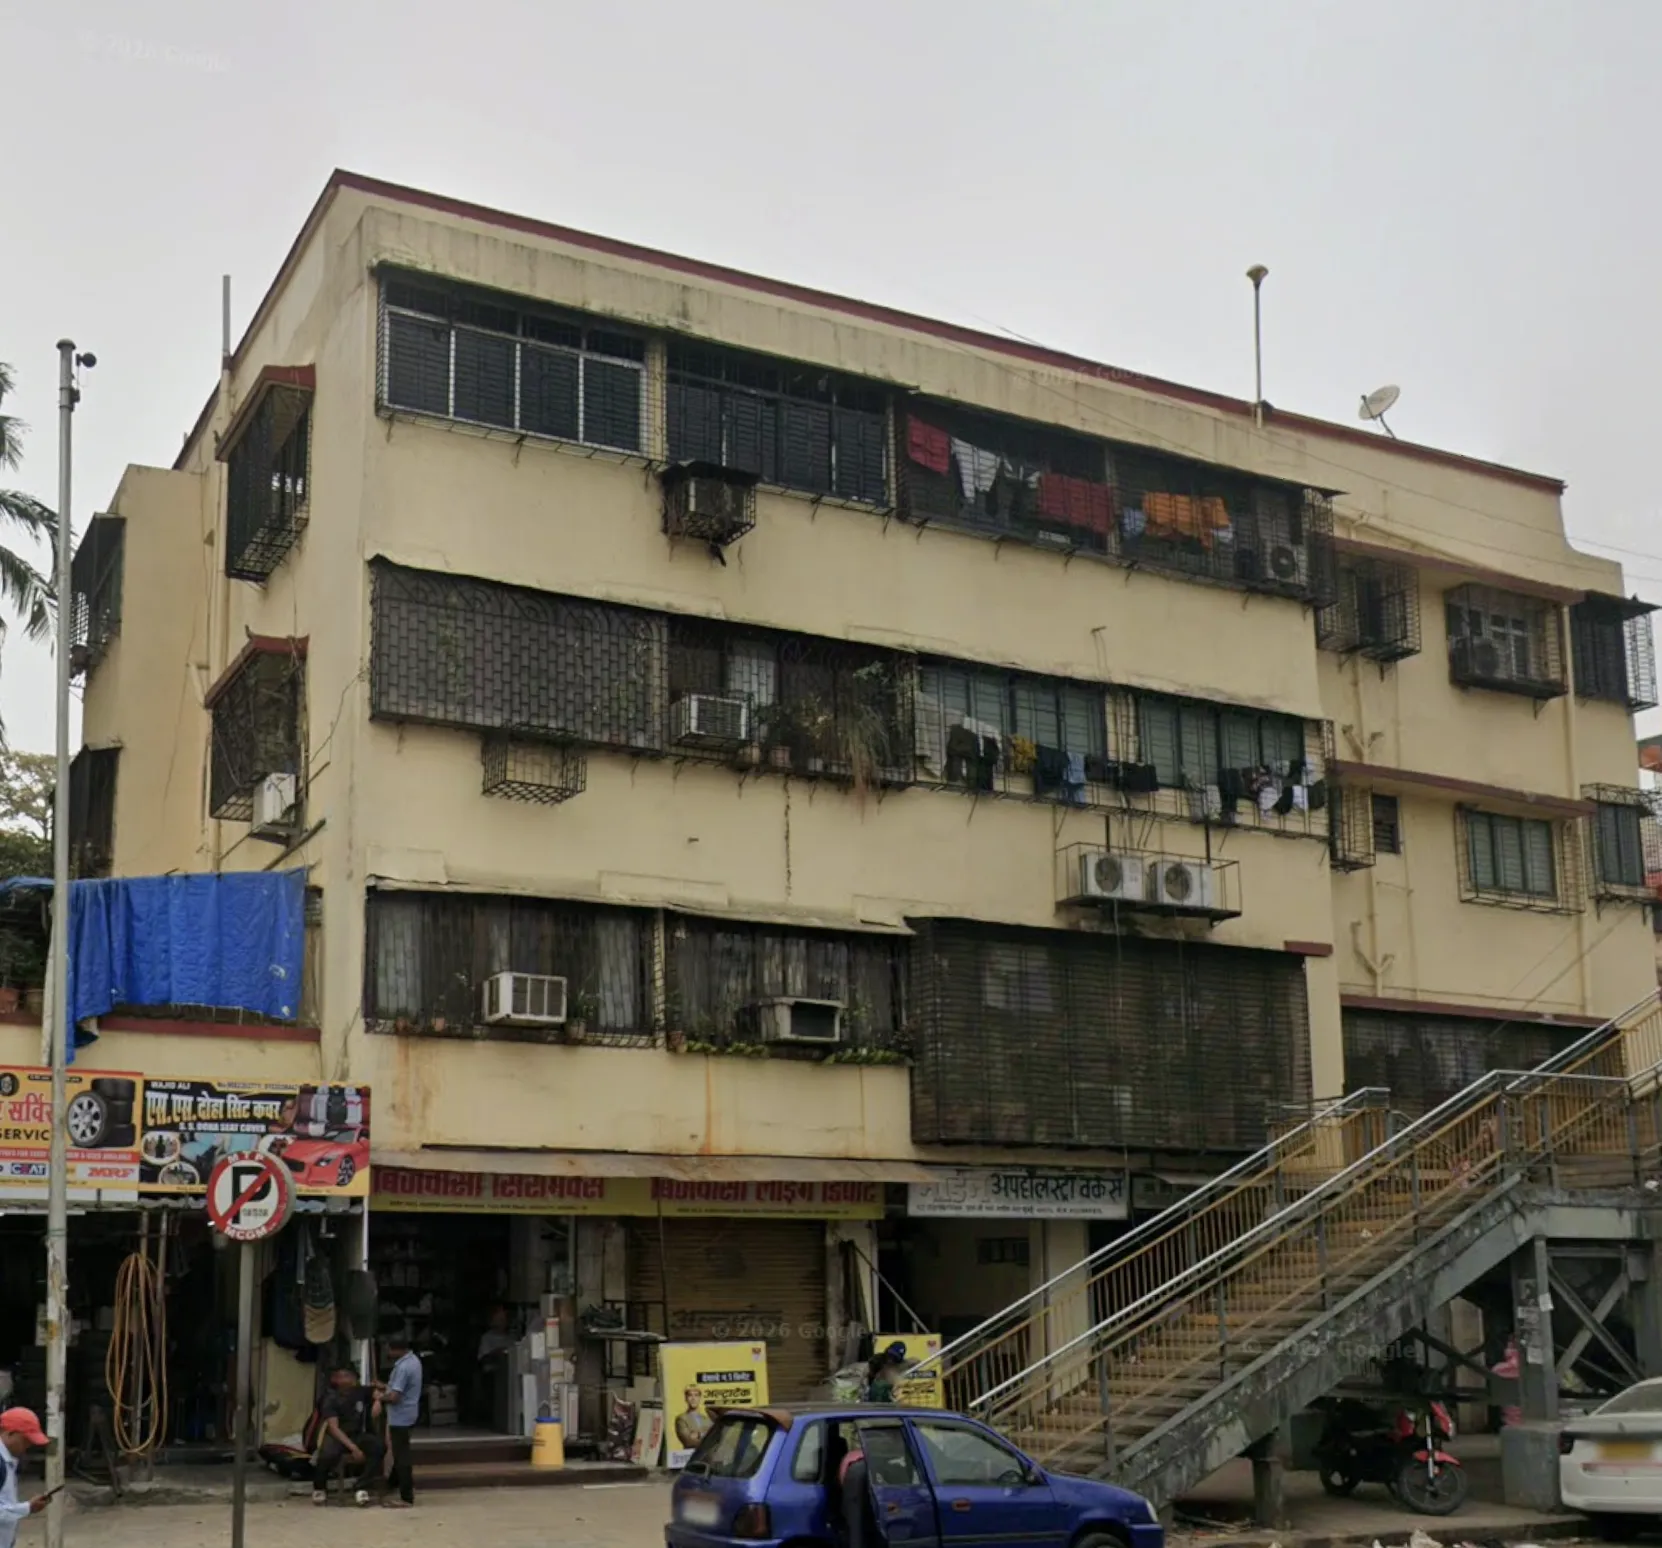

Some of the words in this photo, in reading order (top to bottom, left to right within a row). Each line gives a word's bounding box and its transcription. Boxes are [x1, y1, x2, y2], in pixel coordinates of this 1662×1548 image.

[177, 1081, 191, 1090] ALI
[0, 1127, 50, 1142] SERVIC
[12, 1163, 46, 1175] CEAT
[224, 1225, 268, 1241] MCGM
